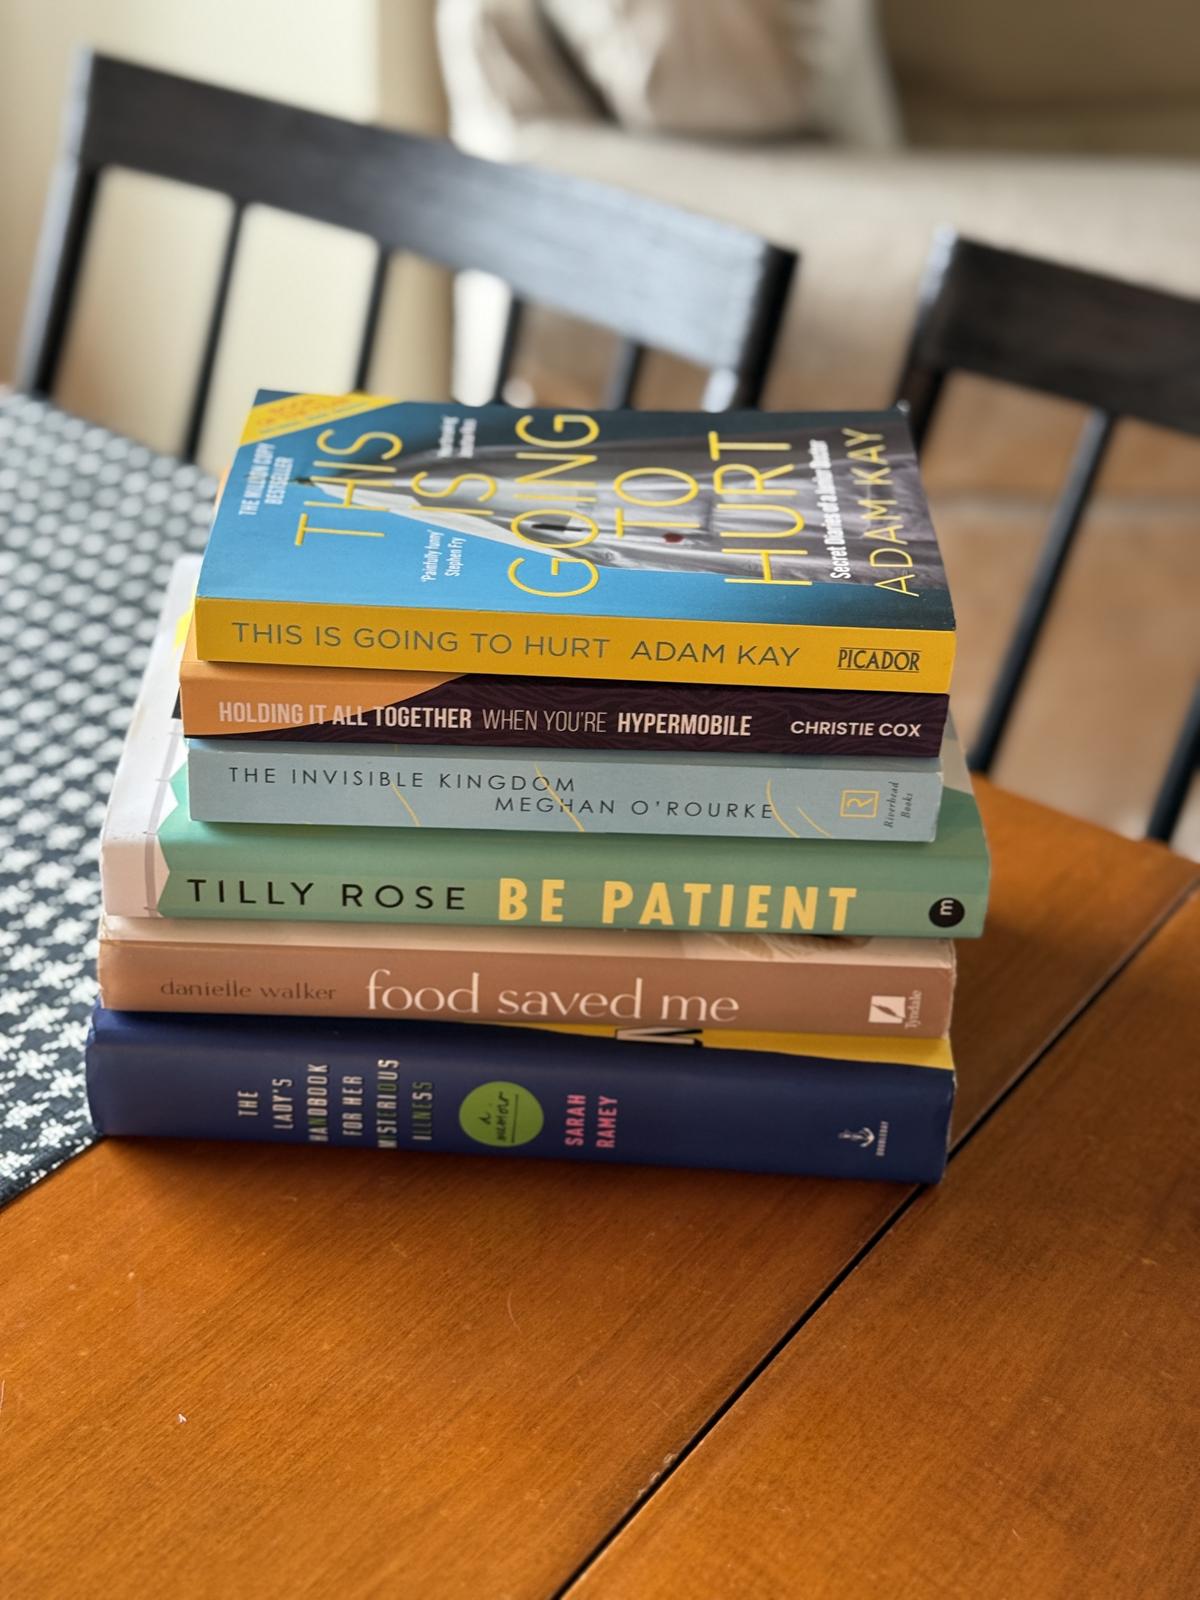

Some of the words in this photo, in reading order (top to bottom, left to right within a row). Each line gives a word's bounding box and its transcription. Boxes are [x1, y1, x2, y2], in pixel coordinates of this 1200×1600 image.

[842, 428, 894, 485] KAY
[265, 457, 294, 505] BESTSELLER
[295, 429, 402, 546] THIS
[411, 471, 497, 516] IS
[613, 466, 701, 539] TO
[238, 499, 259, 515] THE
[508, 414, 600, 597] GOING
[708, 431, 813, 586] HURT
[823, 513, 846, 545] Diaries
[443, 550, 464, 577] Stephen
[447, 536, 468, 549] Fry
[830, 546, 851, 579] Secret
[857, 498, 920, 597] ADAM
[231, 622, 302, 645] THIS
[316, 625, 341, 647] IS
[354, 627, 458, 652] GOING
[471, 633, 512, 655] TO
[525, 636, 610, 659] HURT
[630, 640, 725, 664] ADAM
[738, 645, 800, 667] KAY
[837, 649, 920, 671] PICADOR
[218, 701, 303, 724] HOLDING
[309, 703, 327, 725] IT
[332, 705, 368, 727] ALL
[371, 706, 472, 729] TOGETHER
[482, 708, 537, 731] WHEN
[542, 710, 608, 733] YOU'RE
[617, 713, 752, 736] HYPERMOBILE
[790, 720, 874, 737] CHRISTIE
[879, 722, 921, 738] COX
[229, 766, 276, 784] THE
[292, 769, 423, 788] INVISIBLE
[440, 773, 575, 792] KINGDOM
[495, 797, 614, 815] MEGHAN
[631, 799, 773, 819] O'ROURKE
[883, 781, 899, 829] Riverhead
[186, 878, 314, 906] TILLY
[341, 882, 466, 910] ROSE
[498, 877, 565, 923] BE
[602, 880, 857, 931] PATIENT
[160, 979, 252, 998] danielle
[260, 981, 337, 1001] walker
[366, 968, 480, 1014] food
[497, 978, 643, 1020] saved
[661, 996, 739, 1022] me
[237, 1090, 259, 1116] THE
[272, 1078, 294, 1130] LADY'S
[307, 1063, 329, 1142] HANDBOOK
[341, 1075, 363, 1106] HER
[412, 1081, 433, 1141] ILLNESS
[341, 1112, 363, 1136] FOR
[564, 1094, 587, 1147] SARAH
[595, 1095, 619, 1149] RAMEY
